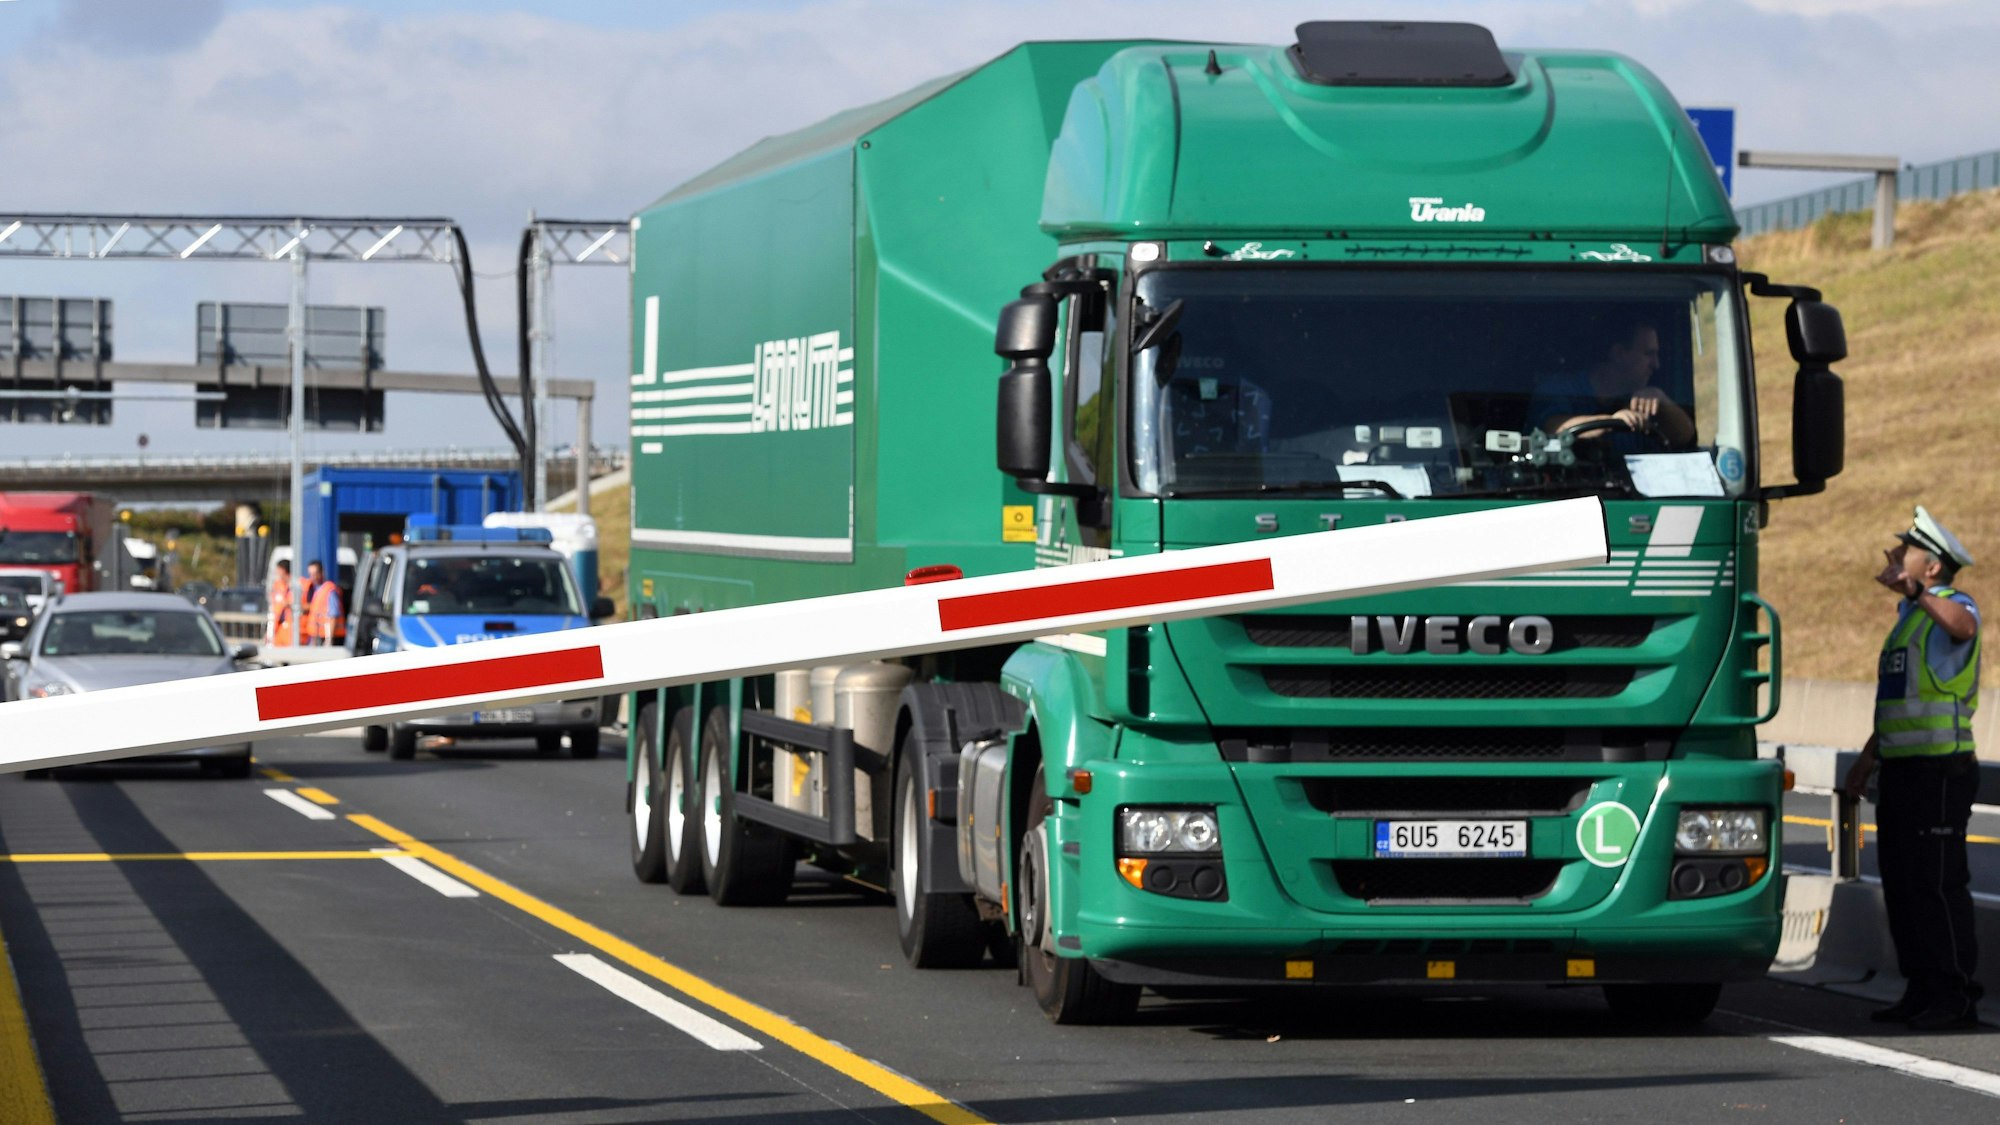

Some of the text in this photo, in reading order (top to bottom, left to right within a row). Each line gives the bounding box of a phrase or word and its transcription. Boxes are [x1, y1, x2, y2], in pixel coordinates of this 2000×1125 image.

[1410, 203, 1485, 222] Urania
[1351, 615, 1554, 655] IVECO
[1396, 825, 1514, 848] 6U5 6245
[1595, 815, 1622, 854] L
